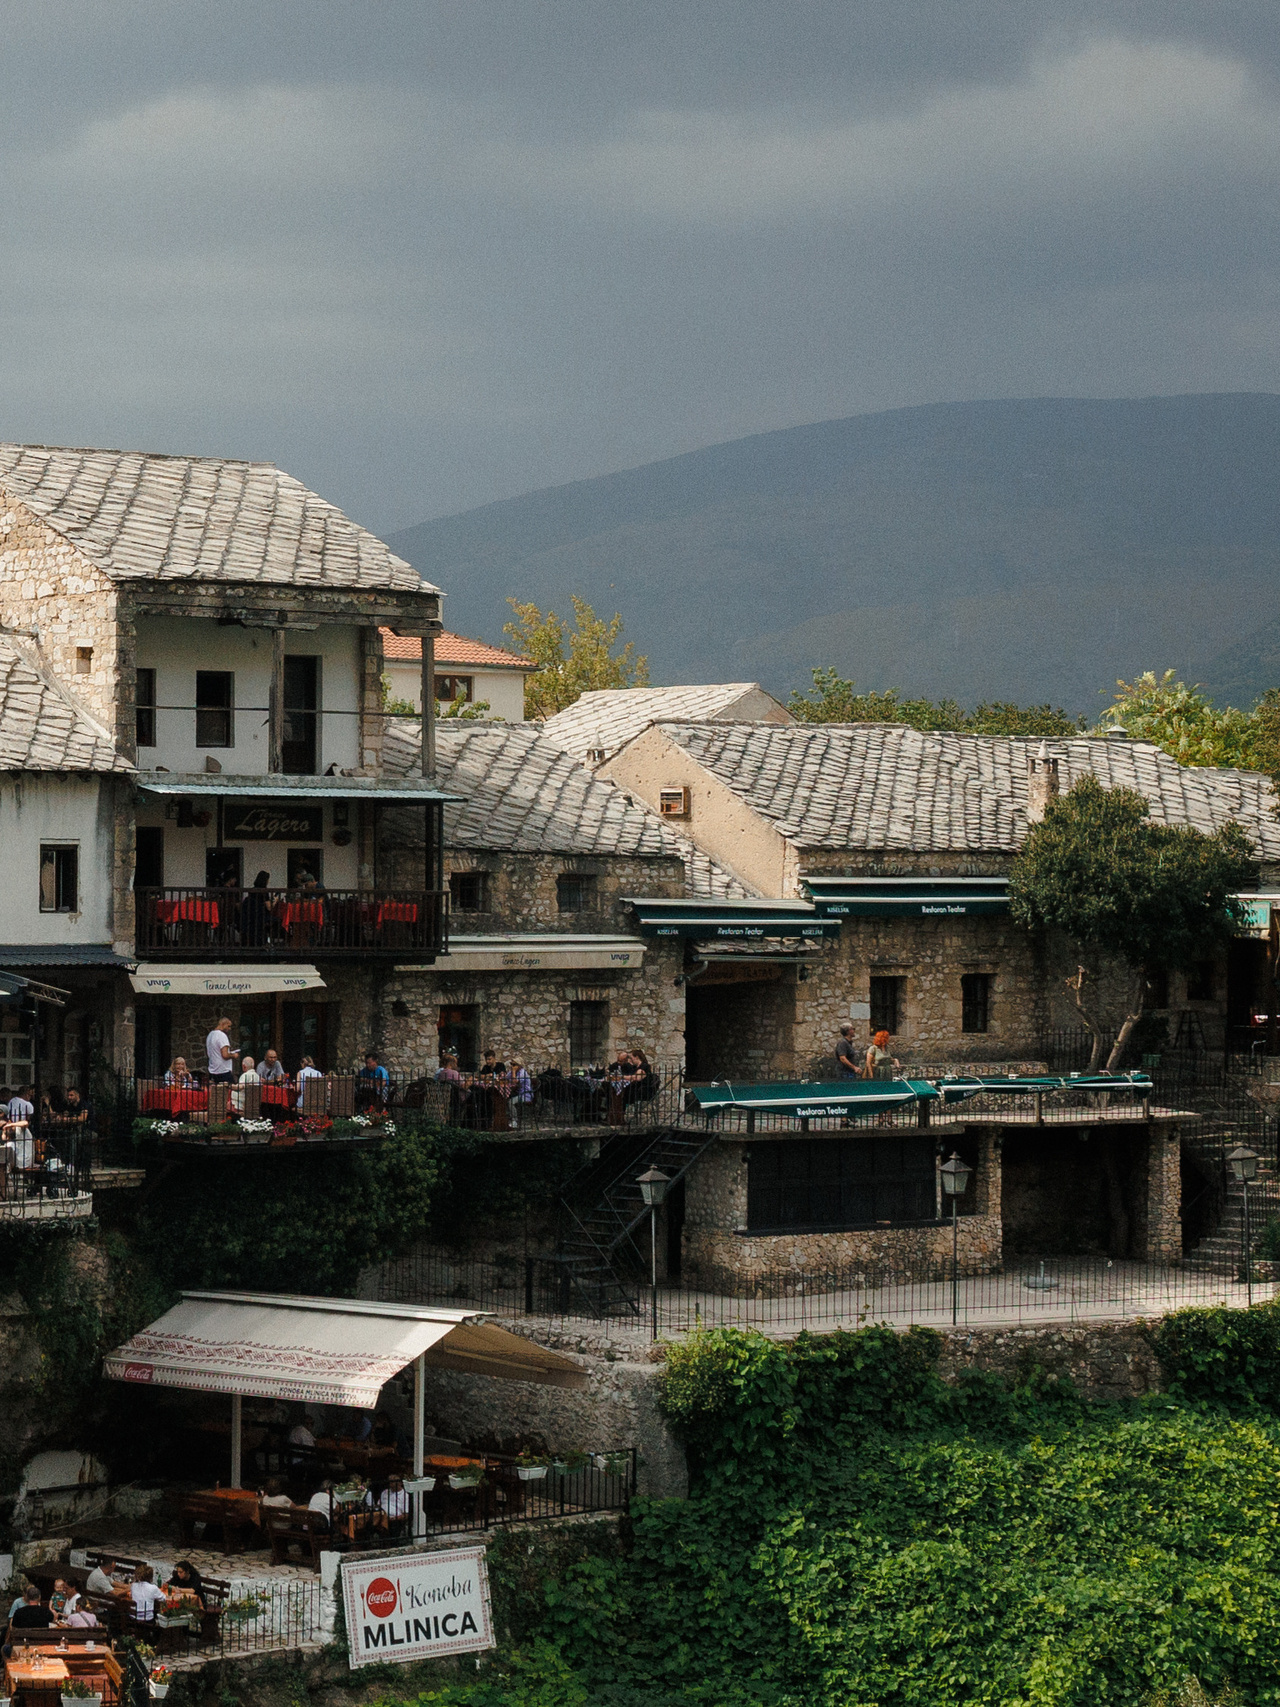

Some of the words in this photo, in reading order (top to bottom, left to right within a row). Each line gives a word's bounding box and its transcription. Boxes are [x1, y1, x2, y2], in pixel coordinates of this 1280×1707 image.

[235, 809, 311, 839] Lagero
[921, 905, 946, 913] Restoran
[947, 905, 966, 913] Teatar
[717, 927, 744, 935] Restoran
[744, 927, 764, 935] Teatar
[796, 1107, 826, 1116] Restoran
[826, 1106, 848, 1115] Teatar
[331, 1392, 357, 1400] NERETVA
[405, 1575, 472, 1610] Konoba
[363, 1611, 479, 1649] MLINICA
